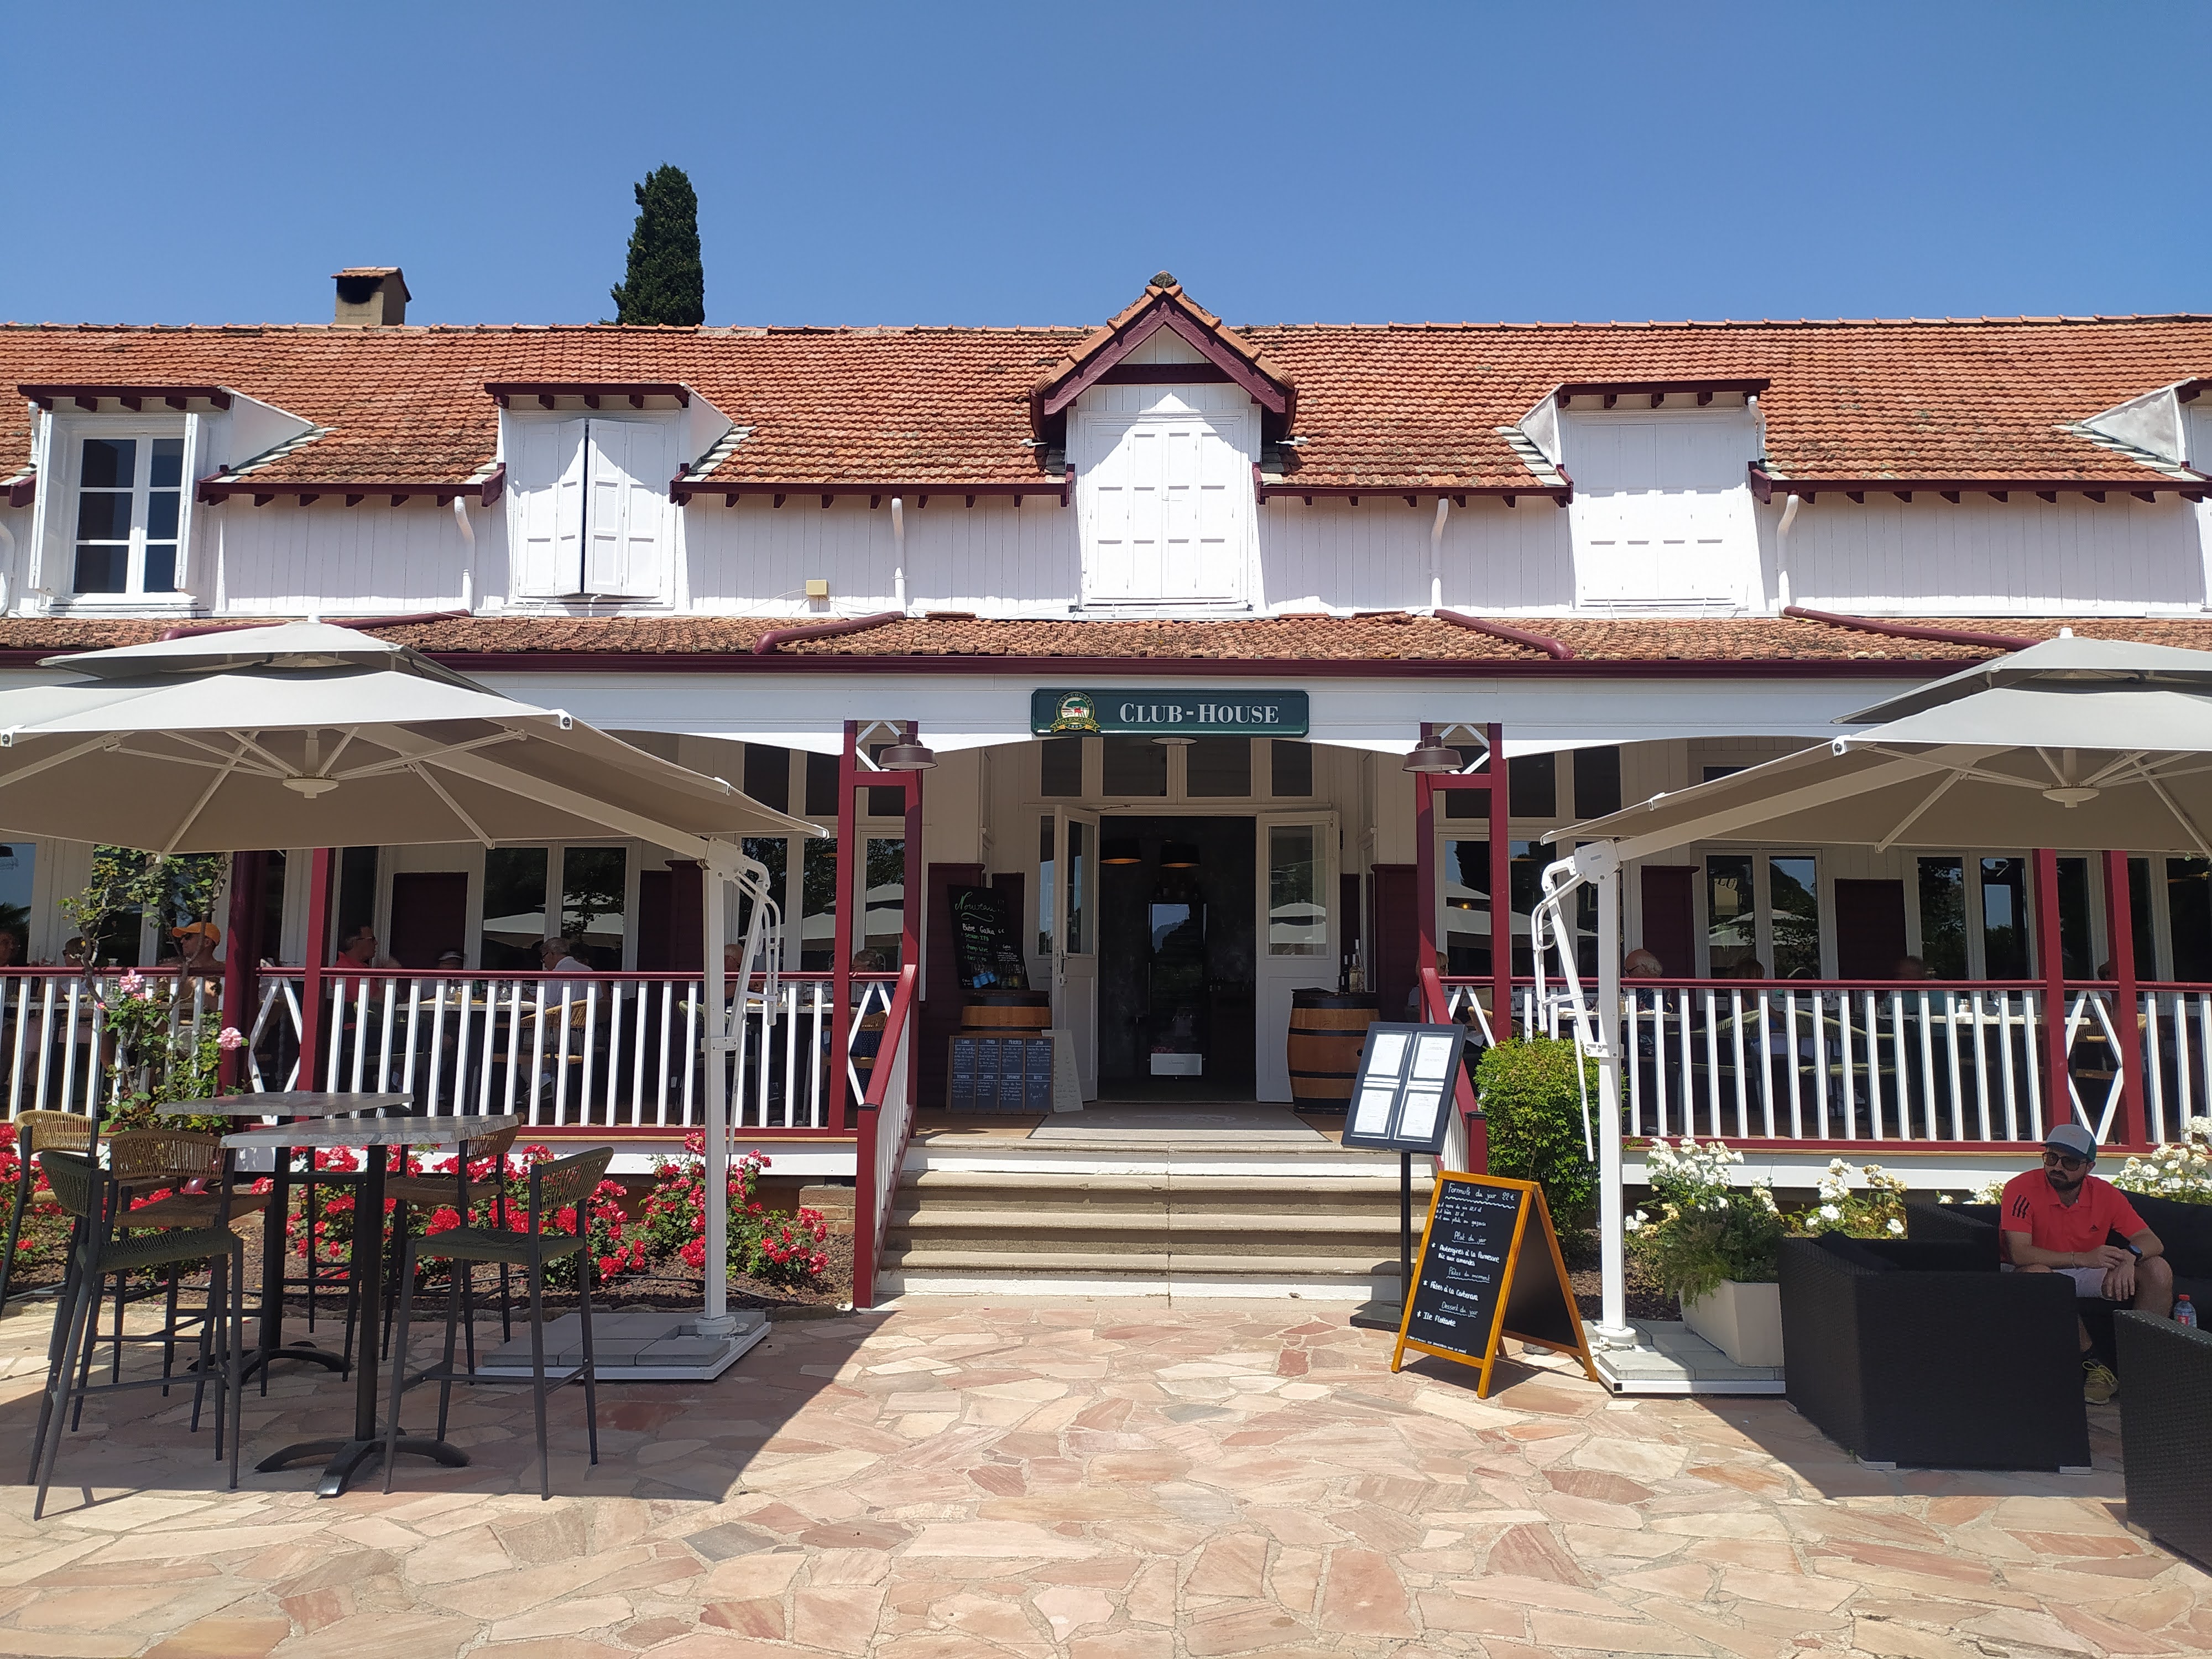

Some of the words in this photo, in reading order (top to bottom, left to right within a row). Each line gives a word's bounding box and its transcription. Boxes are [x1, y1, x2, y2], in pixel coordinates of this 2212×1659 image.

[1058, 696, 1068, 707] OLD
[1119, 702, 1279, 724] CLUB-HOUSE
[1057, 717, 1094, 726] VALESCURE
[1448, 1182, 1471, 1196] Formule
[1475, 1189, 1483, 1198] du
[1485, 1190, 1497, 1201] jour
[1454, 1230, 1465, 1240] Plat
[1477, 1235, 1487, 1245] jour
[1439, 1244, 1464, 1256] Aubergines
[1455, 1257, 1475, 1266] amandes
[1448, 1266, 1461, 1276] Pâtes
[1430, 1280, 1443, 1291] Pâtes
[1443, 1285, 1449, 1293] à
[1441, 1301, 1459, 1311] Dessert
[1459, 1305, 1467, 1313] du
[1468, 1306, 1478, 1317] jour
[1422, 1311, 1433, 1321] Ile
